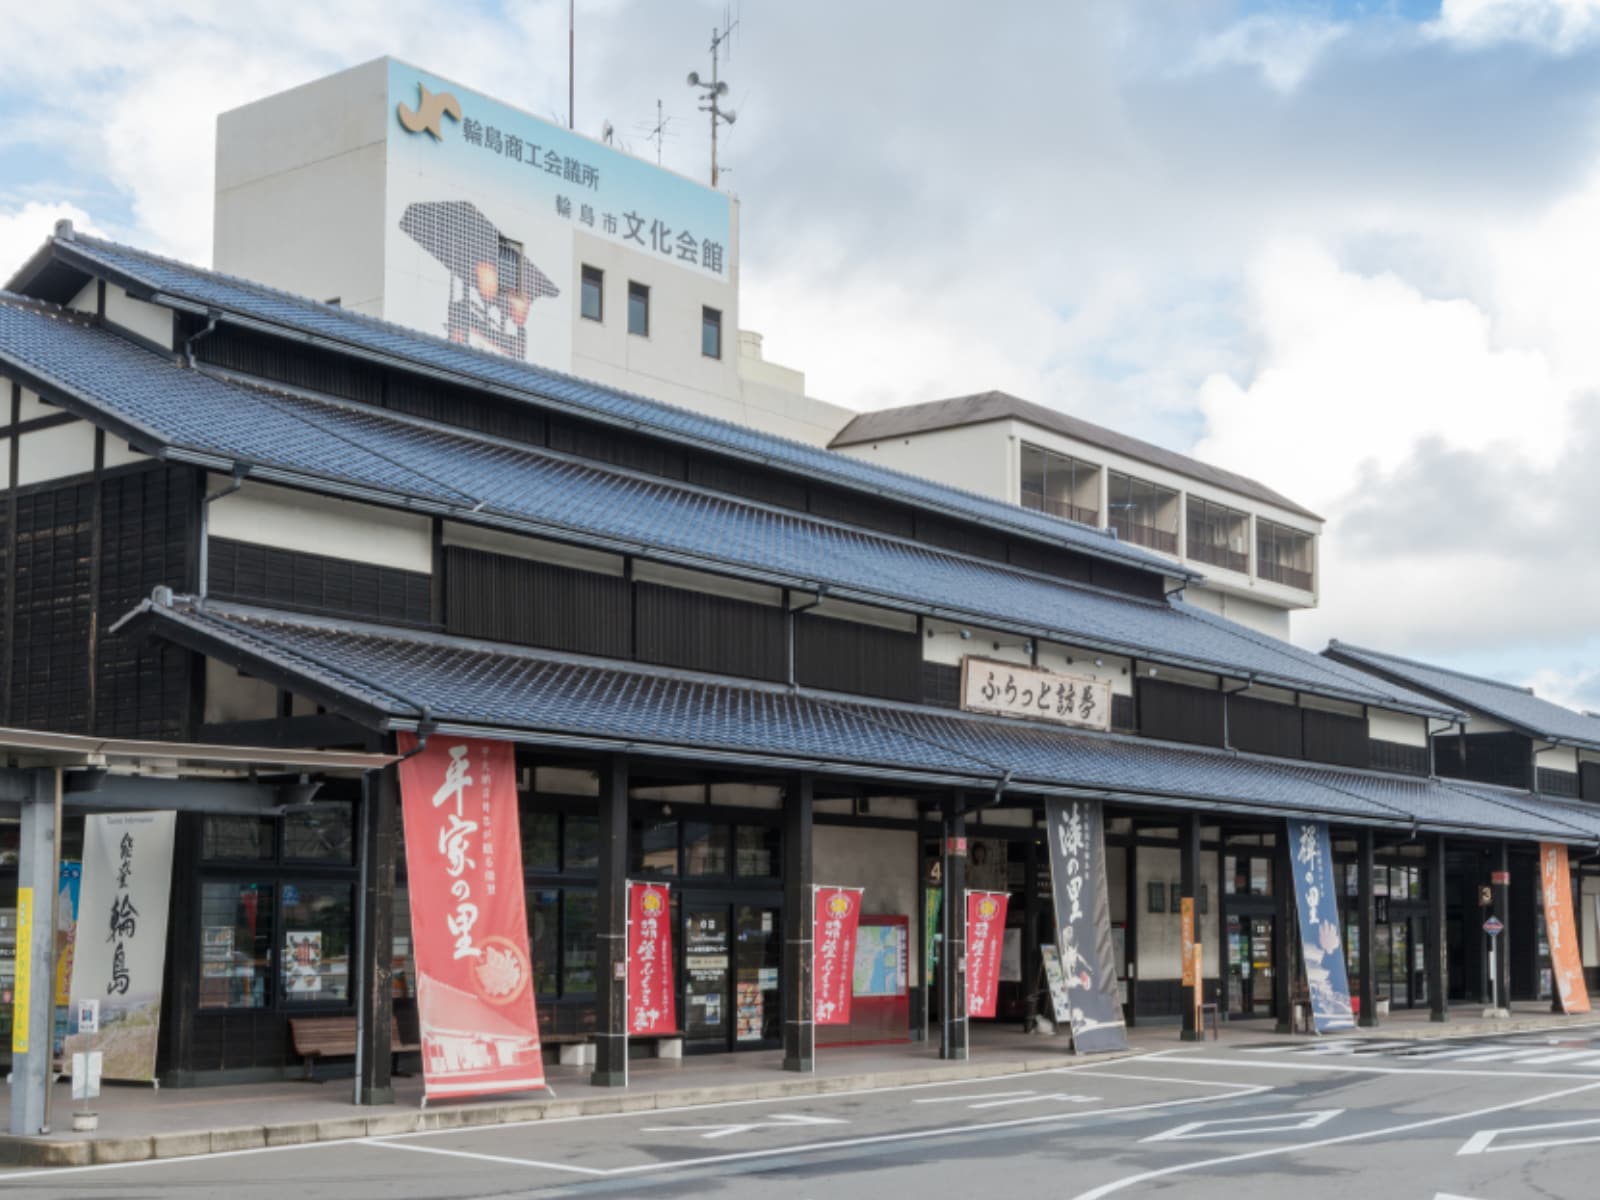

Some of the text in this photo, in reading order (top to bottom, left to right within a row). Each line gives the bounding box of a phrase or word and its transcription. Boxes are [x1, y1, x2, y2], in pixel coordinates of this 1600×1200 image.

[463, 117, 599, 192] 輪島商工会議所
[555, 194, 724, 275] 輪島市 文化会館
[431, 744, 482, 961] 平家の里
[930, 862, 943, 882] 4
